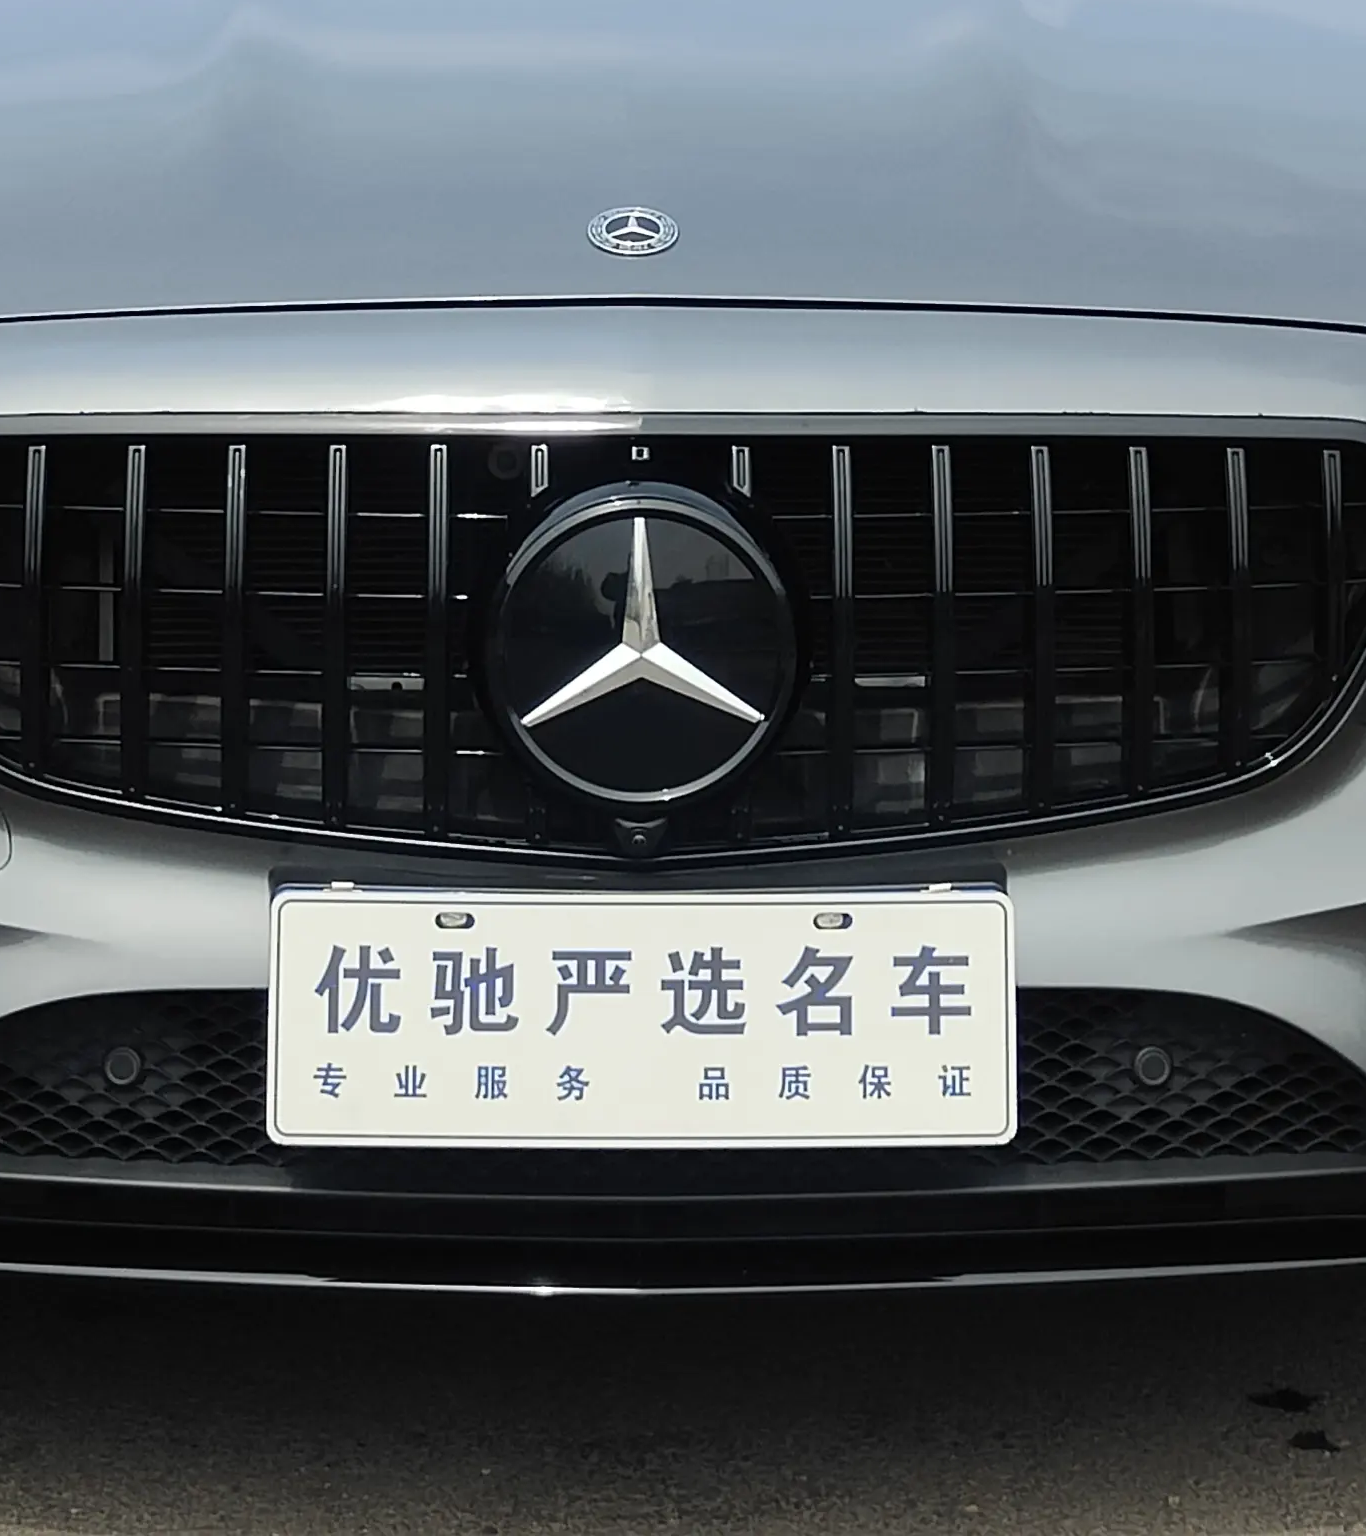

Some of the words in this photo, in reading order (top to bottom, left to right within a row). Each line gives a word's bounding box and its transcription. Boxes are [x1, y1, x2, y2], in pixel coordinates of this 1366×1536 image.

[315, 945, 973, 1036] 优驰严选名车
[313, 1063, 591, 1101] 专业服务
[698, 1065, 973, 1101] 品质保证
